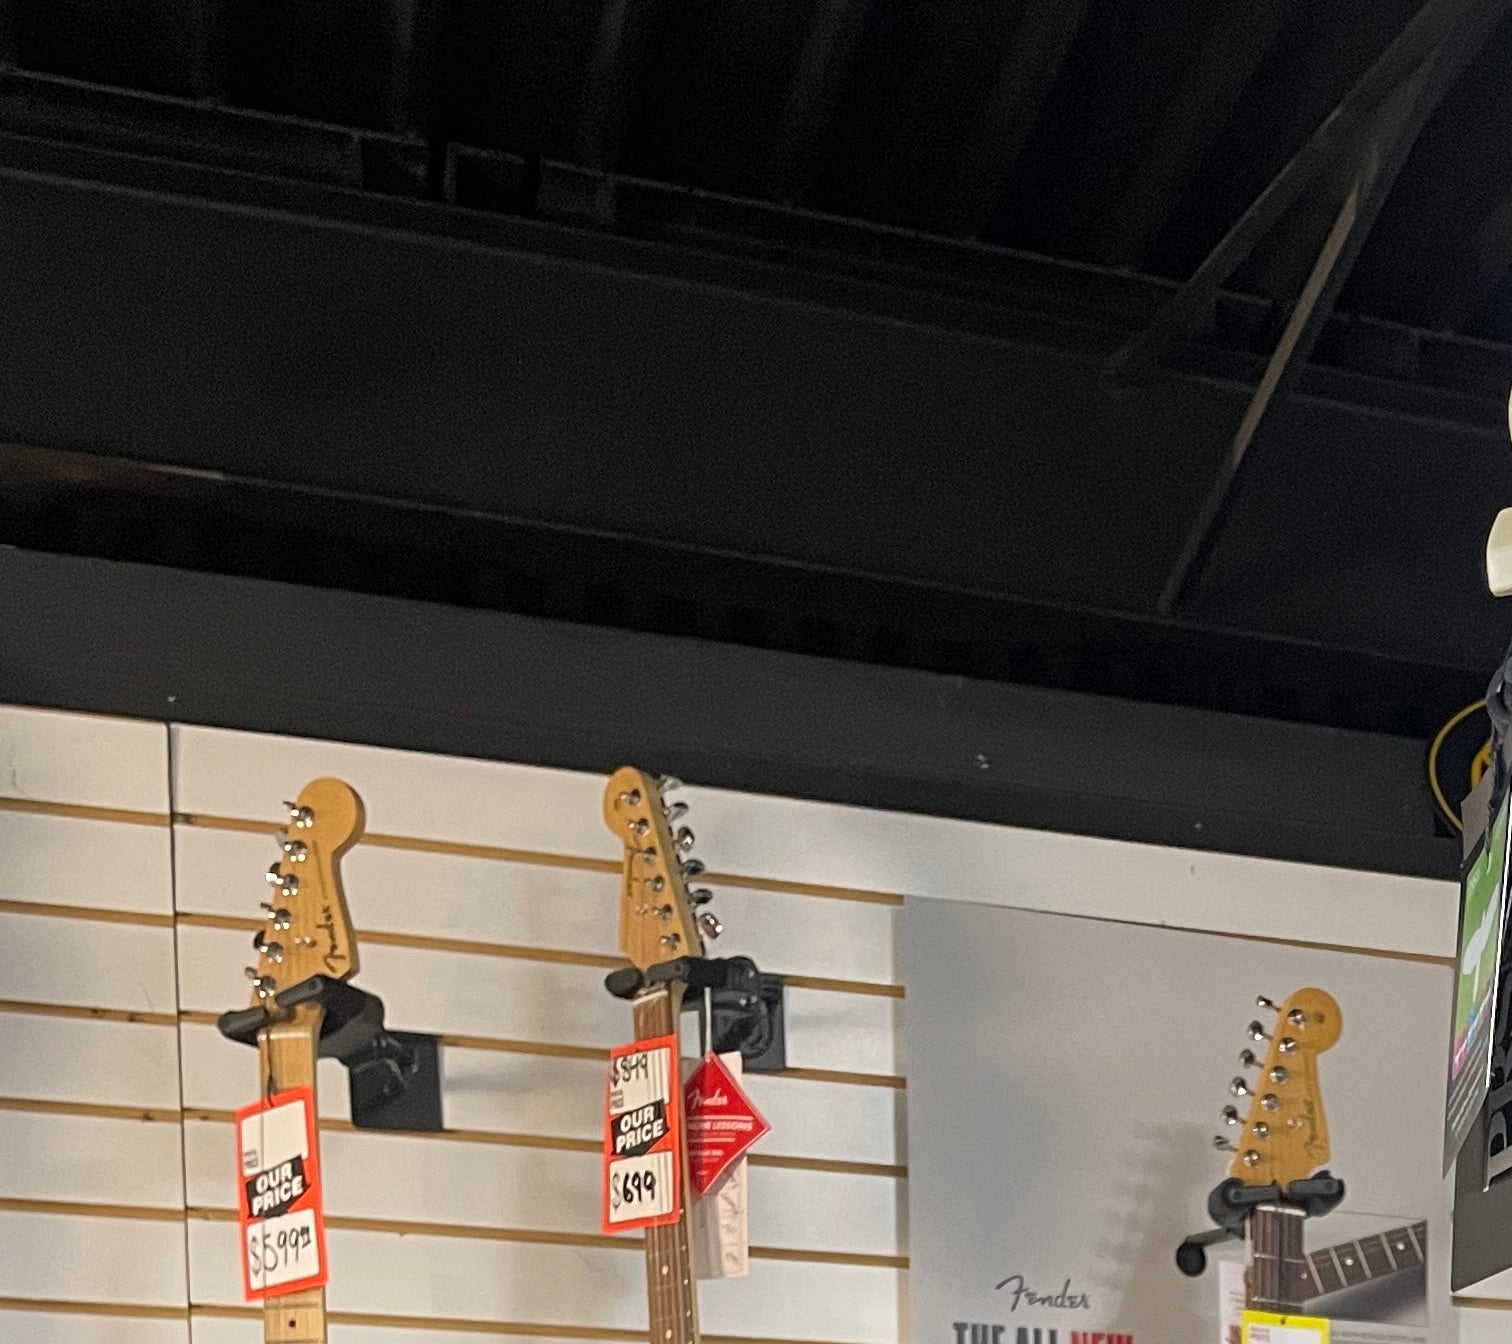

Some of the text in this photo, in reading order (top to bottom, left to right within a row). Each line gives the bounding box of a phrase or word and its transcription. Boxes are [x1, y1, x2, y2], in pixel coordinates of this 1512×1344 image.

[614, 1117, 664, 1155] PRICE
[619, 1104, 656, 1134] OUR
[251, 1174, 304, 1218] PRICE
[254, 1161, 293, 1193] OUR
[611, 1169, 657, 1211] $699
[994, 1274, 1090, 1312] Fender
